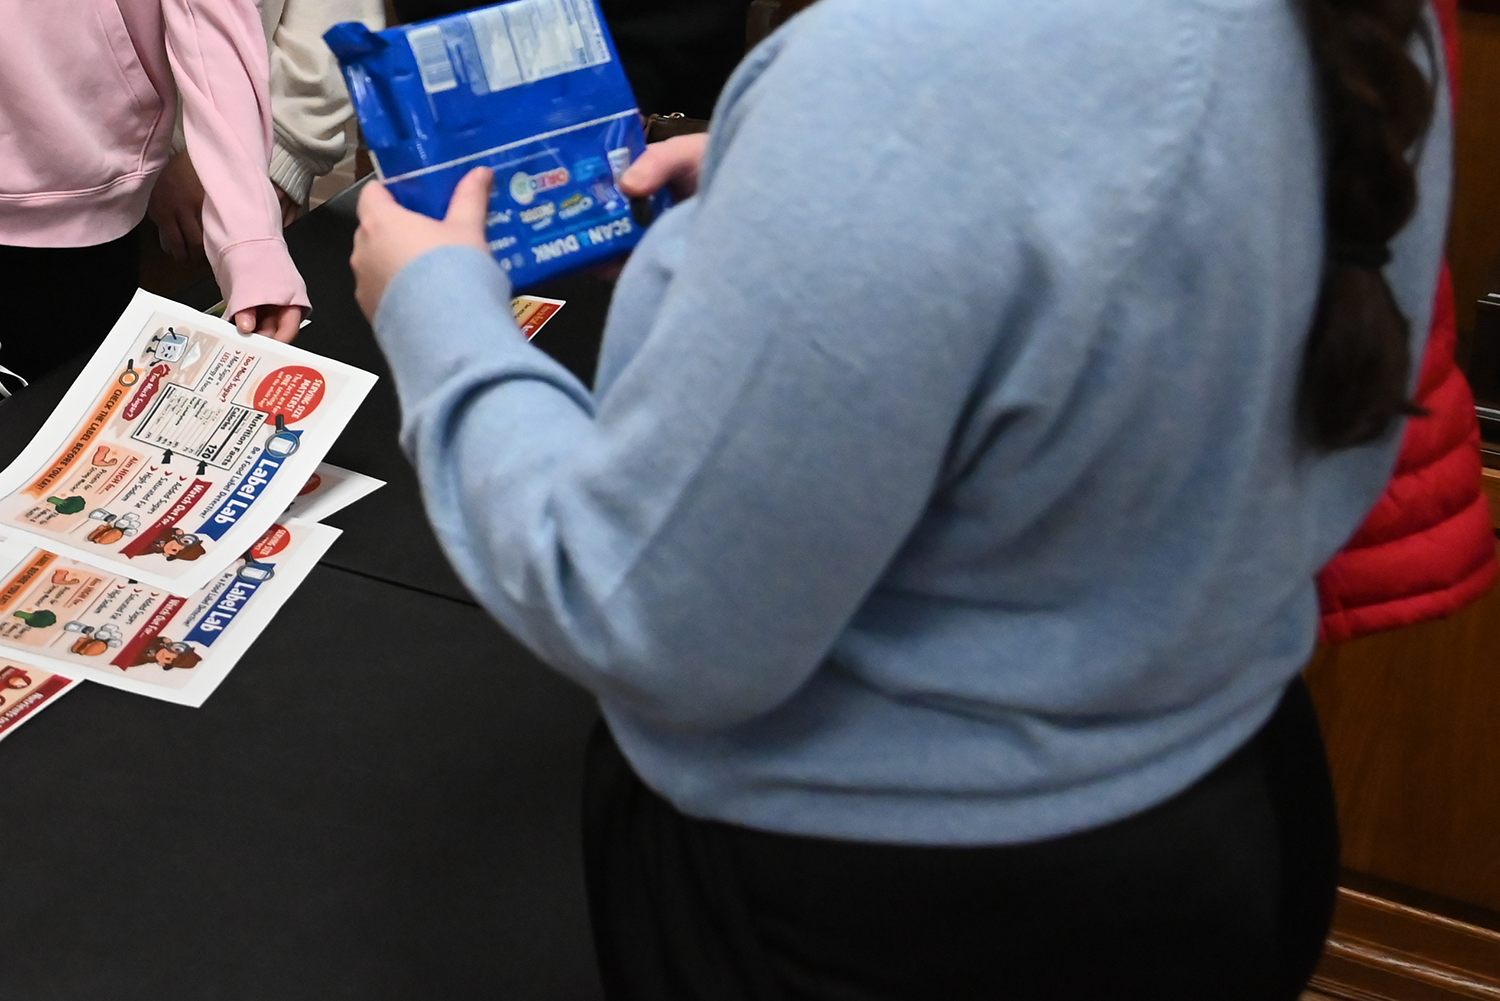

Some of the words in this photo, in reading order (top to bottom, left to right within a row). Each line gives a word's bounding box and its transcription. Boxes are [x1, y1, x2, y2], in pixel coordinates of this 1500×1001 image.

[588, 217, 630, 243] SCAN
[532, 235, 578, 261] DUNK
[219, 351, 230, 363] LESS
[226, 355, 239, 368] More
[243, 355, 255, 366] Too
[149, 372, 159, 382] Too
[209, 362, 223, 376] Energy
[217, 368, 230, 381] Sugar
[232, 366, 247, 381] Much
[280, 374, 292, 385] ONE
[139, 382, 153, 397] Much
[219, 382, 236, 402] Sugar?
[282, 383, 296, 396] facts
[285, 379, 310, 411] MATTERS!
[301, 378, 322, 404] SERVING
[104, 389, 122, 409] CHECK
[126, 397, 143, 417] Sugar?
[94, 410, 108, 422] THE
[220, 407, 240, 429] Calories
[291, 404, 305, 418] SIZE
[79, 422, 99, 441] LABEL
[236, 413, 263, 445] Nutrition
[59, 442, 83, 466] BEFORE
[201, 444, 217, 458] 120
[221, 446, 240, 465] Facts
[250, 446, 260, 454] Be
[124, 456, 138, 468] Aim
[235, 460, 250, 475] Food
[47, 466, 63, 478] YOU
[81, 466, 97, 478] Strong
[89, 468, 107, 484] Protein
[111, 468, 128, 483] HIGH
[138, 471, 153, 484] High
[237, 458, 278, 499] Label
[37, 478, 51, 490] EAT!
[142, 477, 168, 501] Saturated
[163, 481, 182, 499] Added
[222, 475, 239, 491] Label
[121, 484, 142, 501] Sodium
[181, 484, 203, 504] Watch
[134, 500, 146, 508] Fat
[147, 498, 167, 514] Sugars
[170, 504, 185, 516] Out
[200, 491, 226, 518] Detective!
[214, 499, 247, 523] Lab
[217, 581, 255, 611] Label
[159, 599, 179, 615] Watch
[150, 614, 165, 625] Out
[200, 610, 231, 631] Lab
[5, 692, 43, 717] Nutrients
